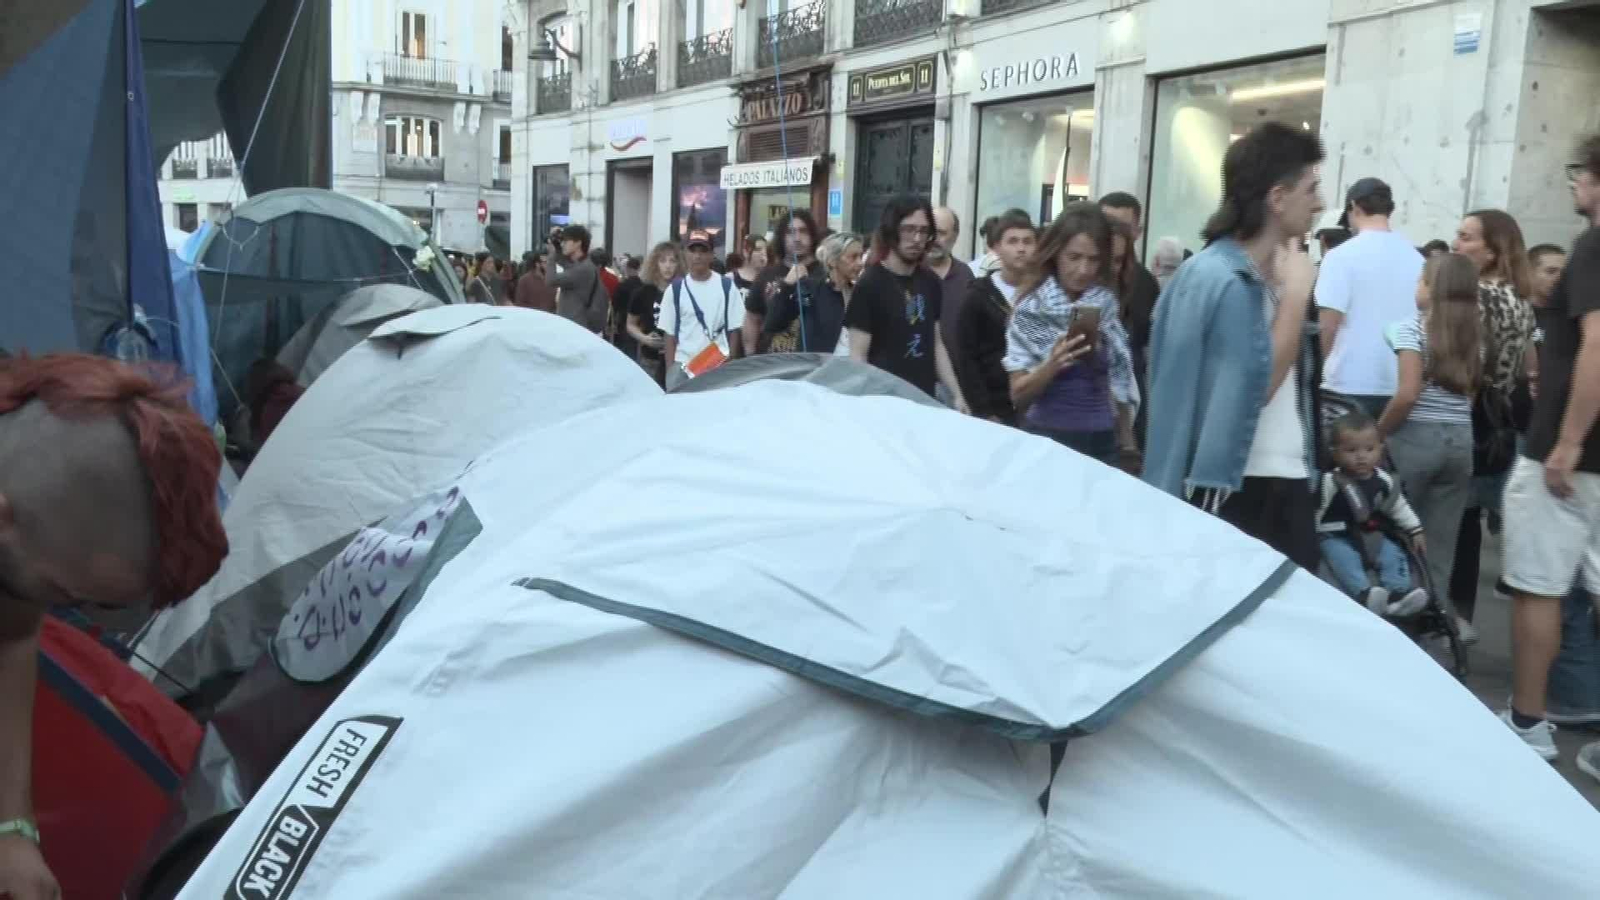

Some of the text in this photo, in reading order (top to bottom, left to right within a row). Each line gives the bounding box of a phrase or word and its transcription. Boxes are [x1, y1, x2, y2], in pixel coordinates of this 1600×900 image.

[920, 68, 929, 84] 11
[980, 52, 1078, 91] SEPHORA
[723, 167, 809, 187] HELADOS ITALIANOS
[306, 728, 368, 799] FRESH
[243, 815, 308, 899] BLACK
